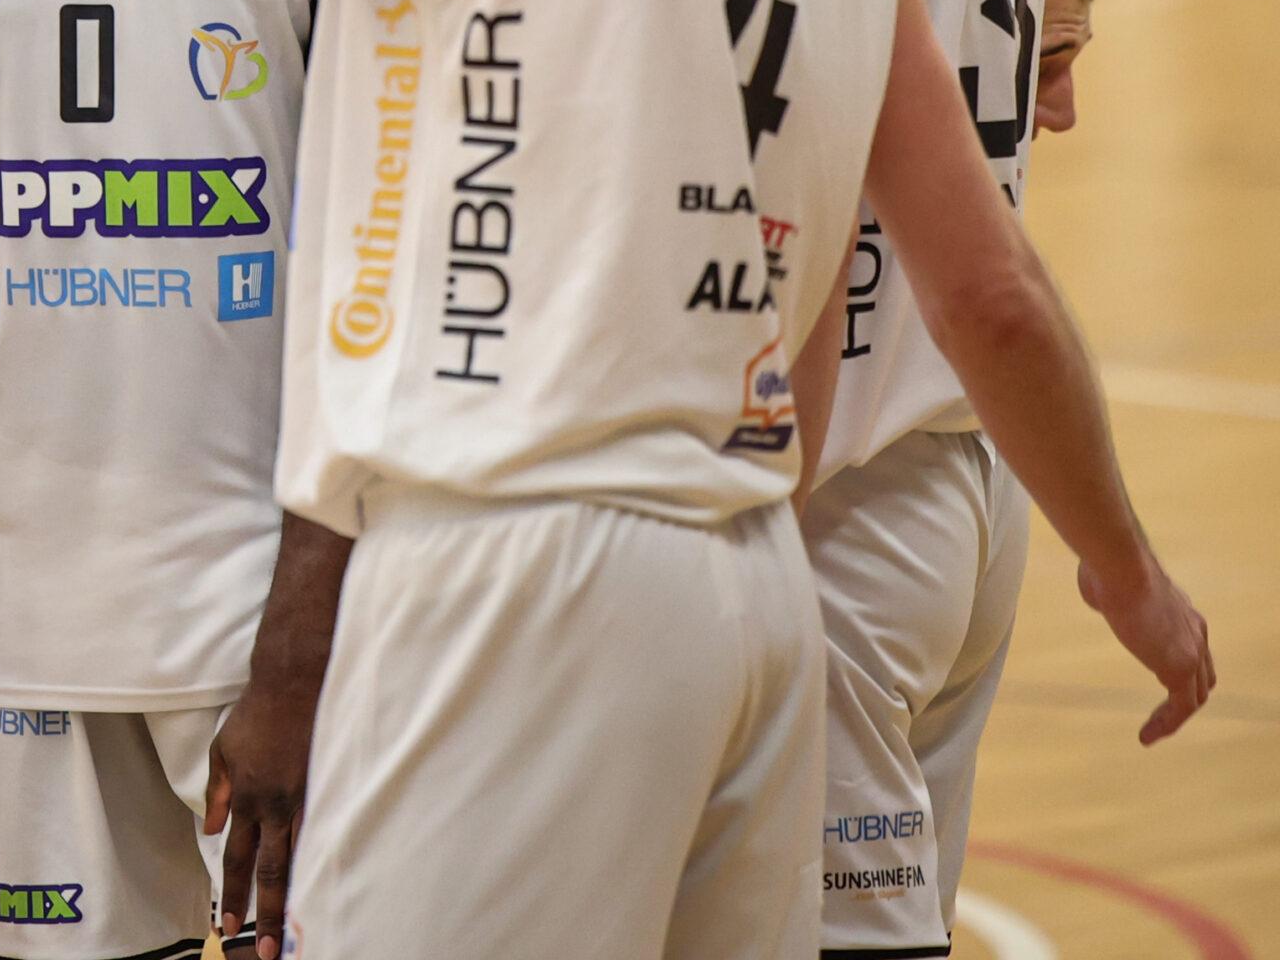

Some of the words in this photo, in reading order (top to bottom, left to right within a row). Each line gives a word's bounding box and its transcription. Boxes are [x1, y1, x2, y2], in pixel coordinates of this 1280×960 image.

[60, 4, 115, 123] 0
[329, 42, 423, 359] Continental
[435, 9, 524, 385] HÜBNER
[5, 267, 193, 309] HÜBNER
[824, 811, 925, 844] HÜBNER
